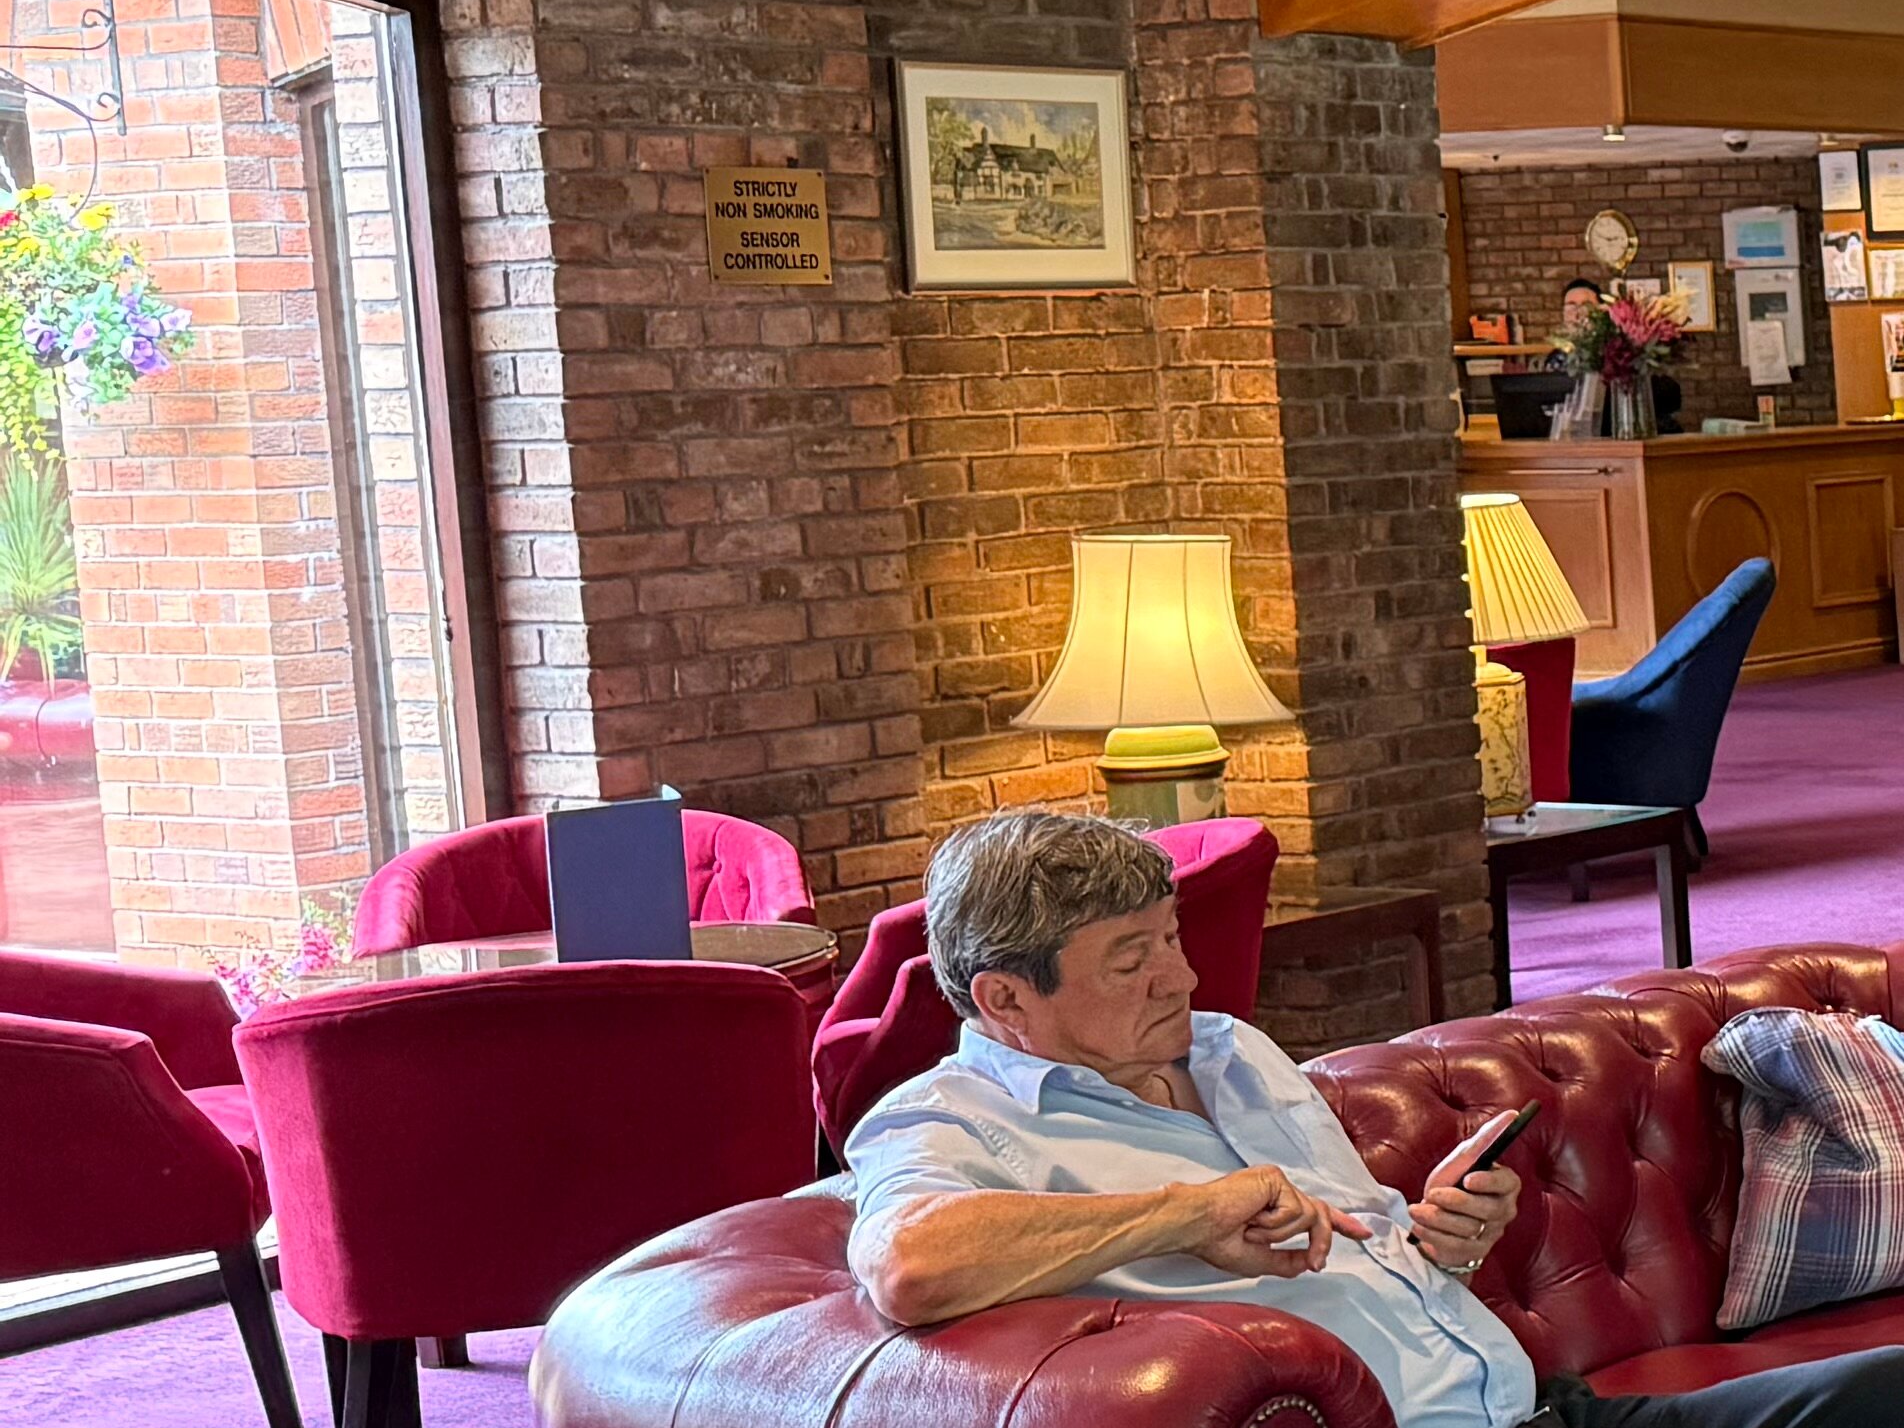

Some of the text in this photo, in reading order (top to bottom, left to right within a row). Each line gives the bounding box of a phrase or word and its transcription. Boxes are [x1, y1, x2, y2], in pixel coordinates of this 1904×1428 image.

[733, 180, 797, 197] STRICTLY
[714, 202, 820, 219] NON SMOKING
[740, 231, 800, 248] SENSOR
[724, 253, 819, 269] CONTROLLED
